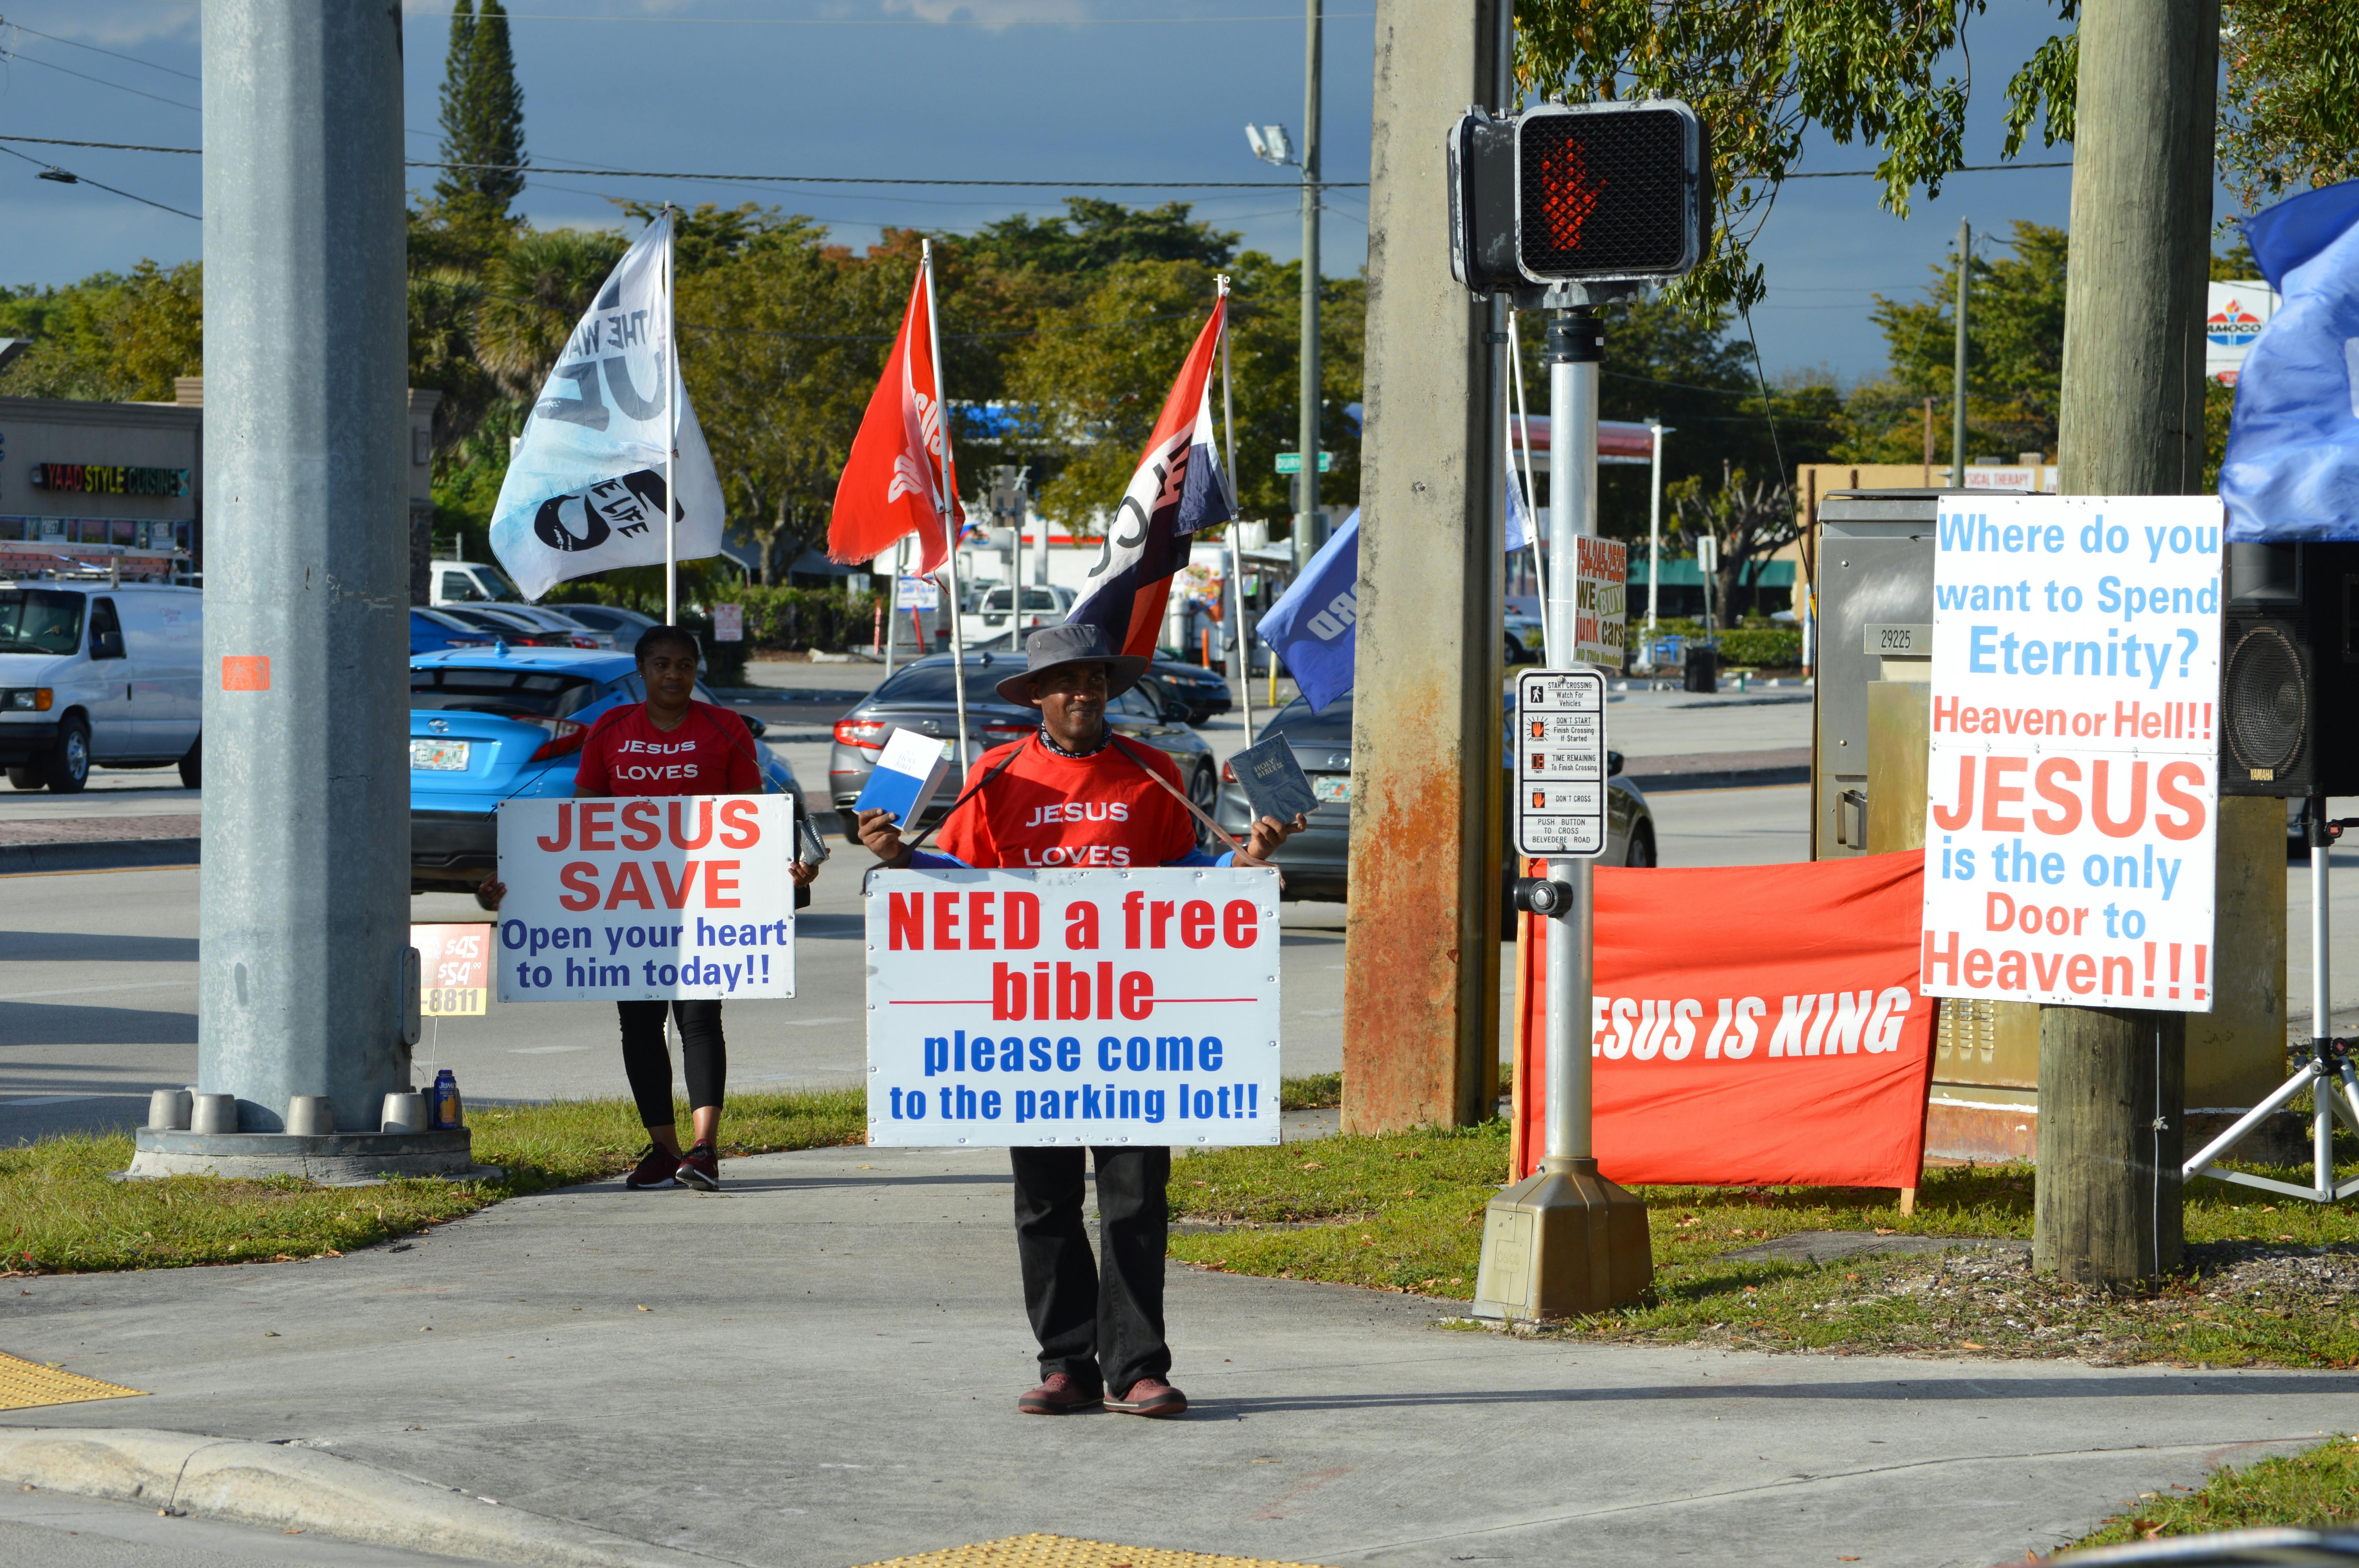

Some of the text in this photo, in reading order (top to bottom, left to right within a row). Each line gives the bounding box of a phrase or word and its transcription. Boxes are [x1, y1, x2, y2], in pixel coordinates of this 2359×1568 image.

[48, 464, 177, 497] YAAD STYLE CUISINE
[1965, 473, 1990, 486] YSICAL
[1939, 514, 2217, 563] Where do you
[1577, 538, 1625, 584] 754-245-2525
[1577, 580, 1622, 615] WE BUY
[1936, 576, 2218, 622] want to Spend
[1575, 610, 1623, 648] junk cars
[1881, 630, 1910, 648] 29225
[1576, 648, 1585, 661] NO
[1601, 652, 1622, 667] Needed
[1970, 626, 2199, 689] Eternity?
[1571, 727, 1594, 735] Crossing
[1934, 696, 2212, 739] Heaven or Hell!!
[618, 740, 696, 754] JESUS
[898, 754, 915, 764] HOLY
[1254, 758, 1274, 772] HOLY
[616, 764, 698, 780] LOVES
[895, 761, 912, 771] BIBLE
[1257, 766, 1277, 778] BIBLE
[1575, 764, 1597, 772] Crossing
[2250, 769, 2273, 781] YAMAHA
[1026, 802, 1128, 827] JESUS
[1933, 755, 2206, 840] JESUS
[537, 800, 760, 852] JESUS
[1024, 846, 1130, 866] LOVES
[1942, 836, 2182, 901] is the only
[559, 860, 741, 911] SAVE
[889, 891, 1258, 951] NEED a free
[1986, 891, 2146, 940] Door to
[445, 936, 480, 958] $45
[502, 917, 787, 956] Open your heart
[517, 955, 769, 992] to him today!!
[1923, 930, 2207, 1000] Heaven!!!
[992, 961, 1154, 1020] bible
[1592, 986, 1911, 1060] ESUS IS KING
[925, 1030, 1223, 1077] please come
[890, 1083, 1258, 1123] to the parking lot!!
